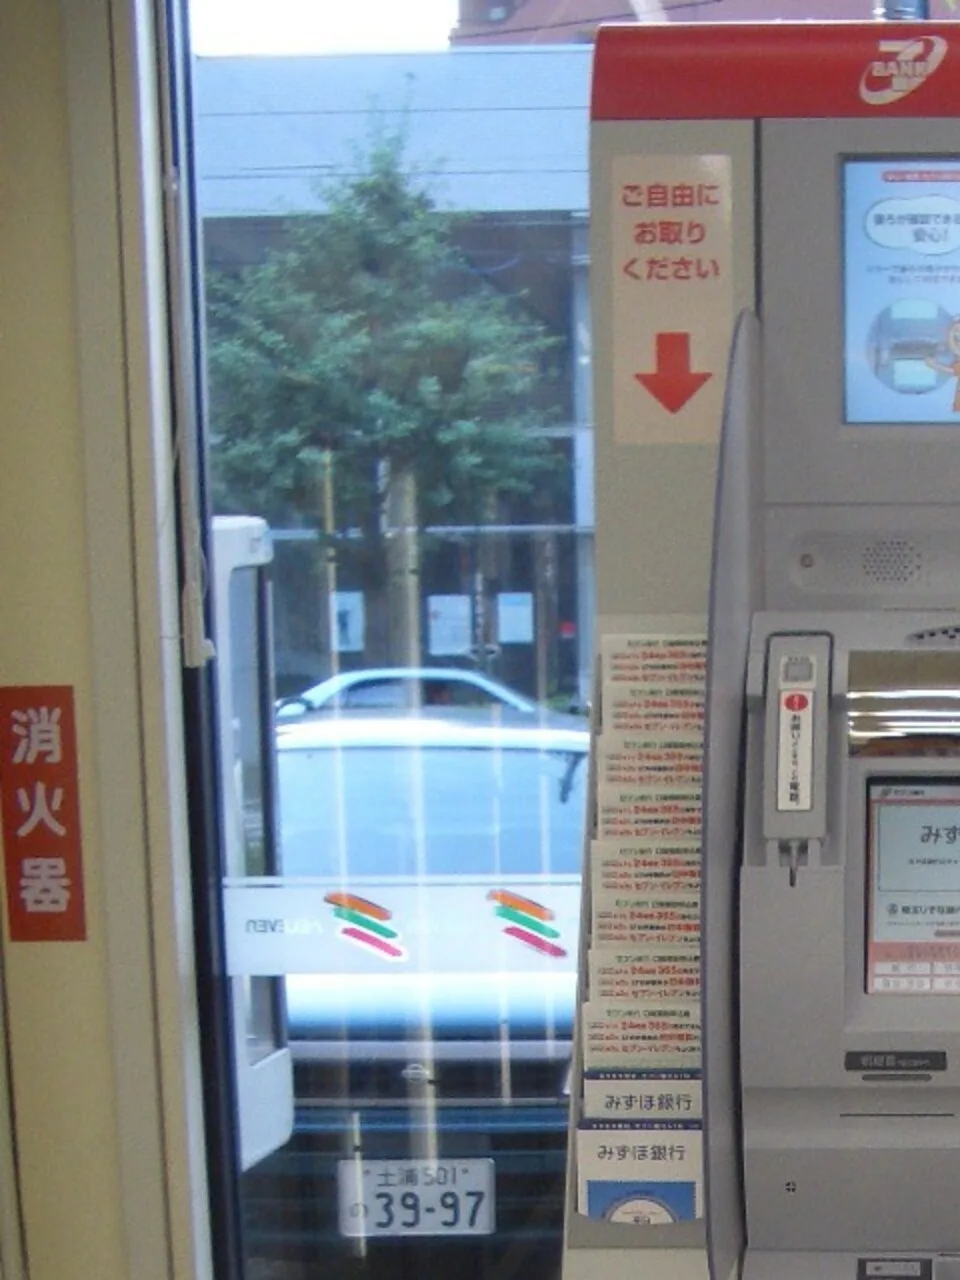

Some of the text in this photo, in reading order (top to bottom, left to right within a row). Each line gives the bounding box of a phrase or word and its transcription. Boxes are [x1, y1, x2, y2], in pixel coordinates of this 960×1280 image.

[622, 183, 719, 207] ご自由に
[634, 221, 706, 244] お取り
[622, 257, 720, 281] ください
[10, 705, 72, 913] 消火器
[604, 1093, 693, 1112] みずほ銀行
[597, 1144, 686, 1162] みずほ銀行
[424, 1167, 457, 1186] 501
[375, 1191, 485, 1229] 39-97
